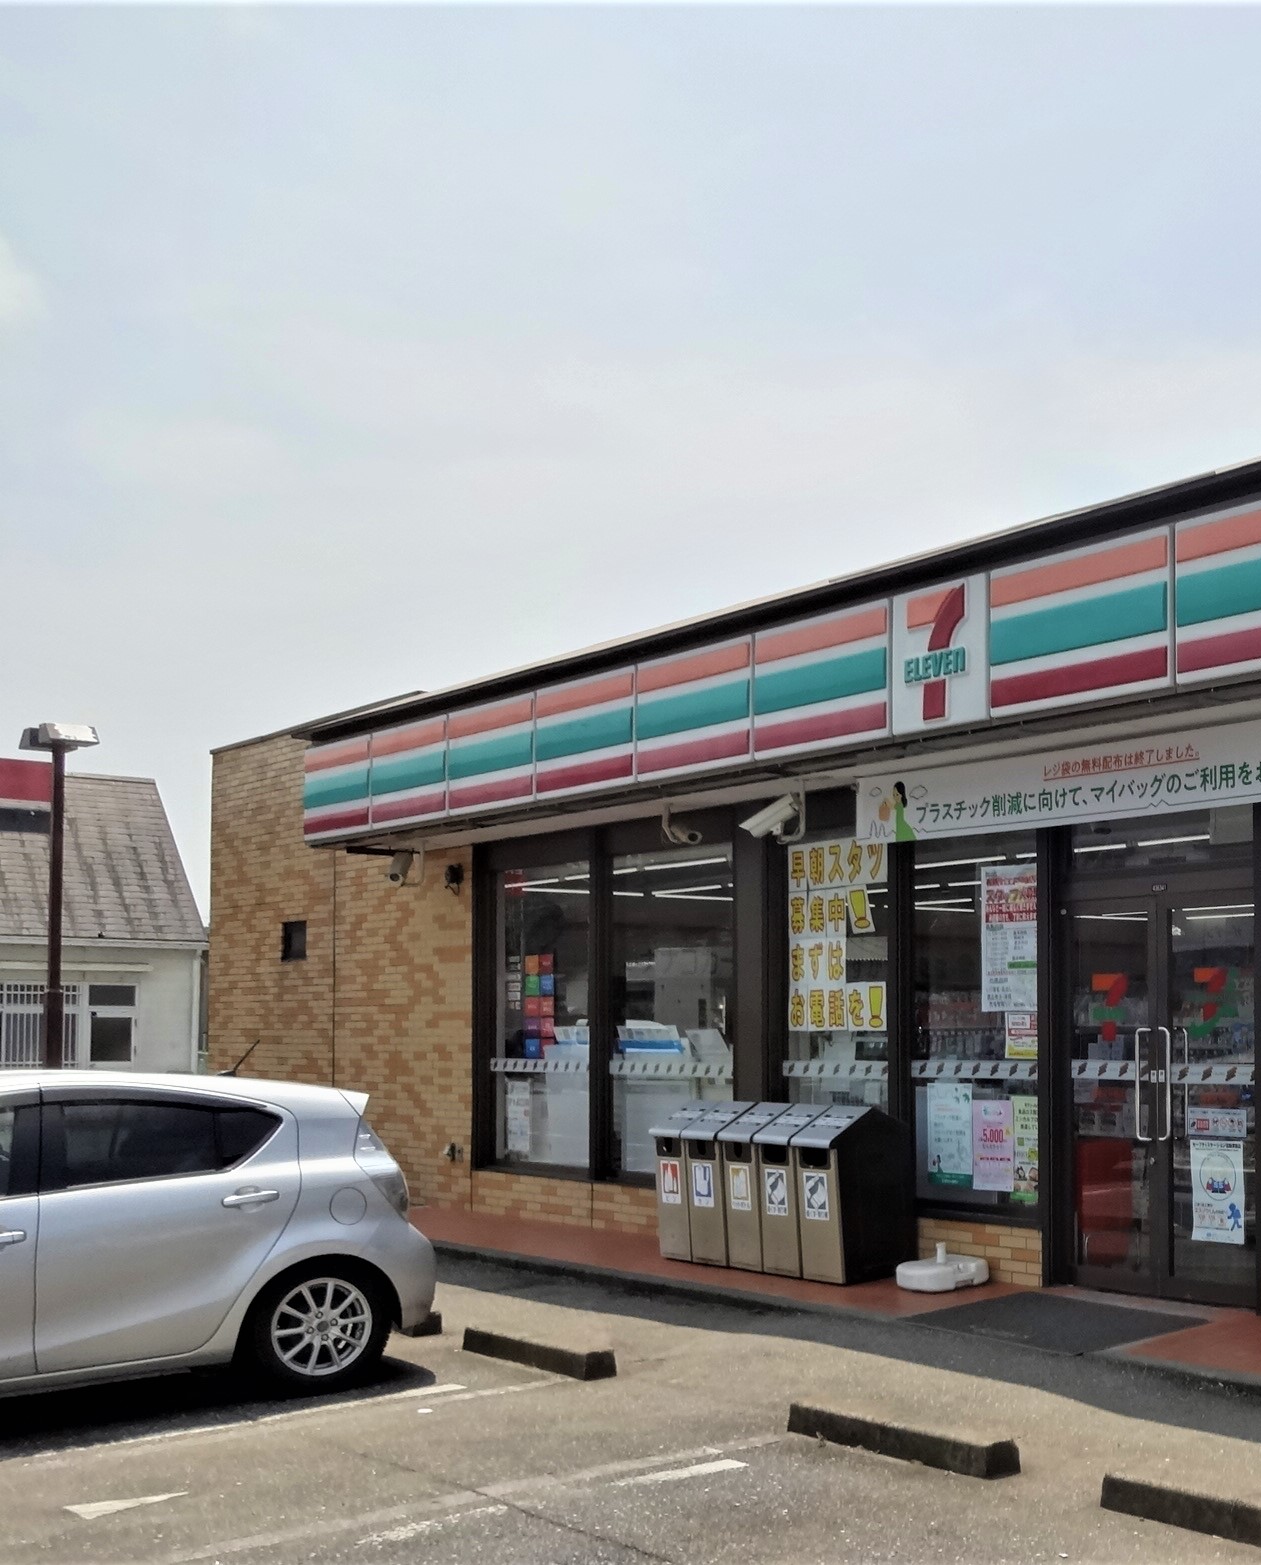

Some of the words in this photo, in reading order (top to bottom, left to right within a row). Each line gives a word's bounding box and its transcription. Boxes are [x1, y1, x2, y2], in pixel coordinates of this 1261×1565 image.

[907, 583, 965, 721] 7
[1043, 743, 1200, 778] レジ袋の無料配布は終了しました。
[791, 940, 844, 981] まずは
